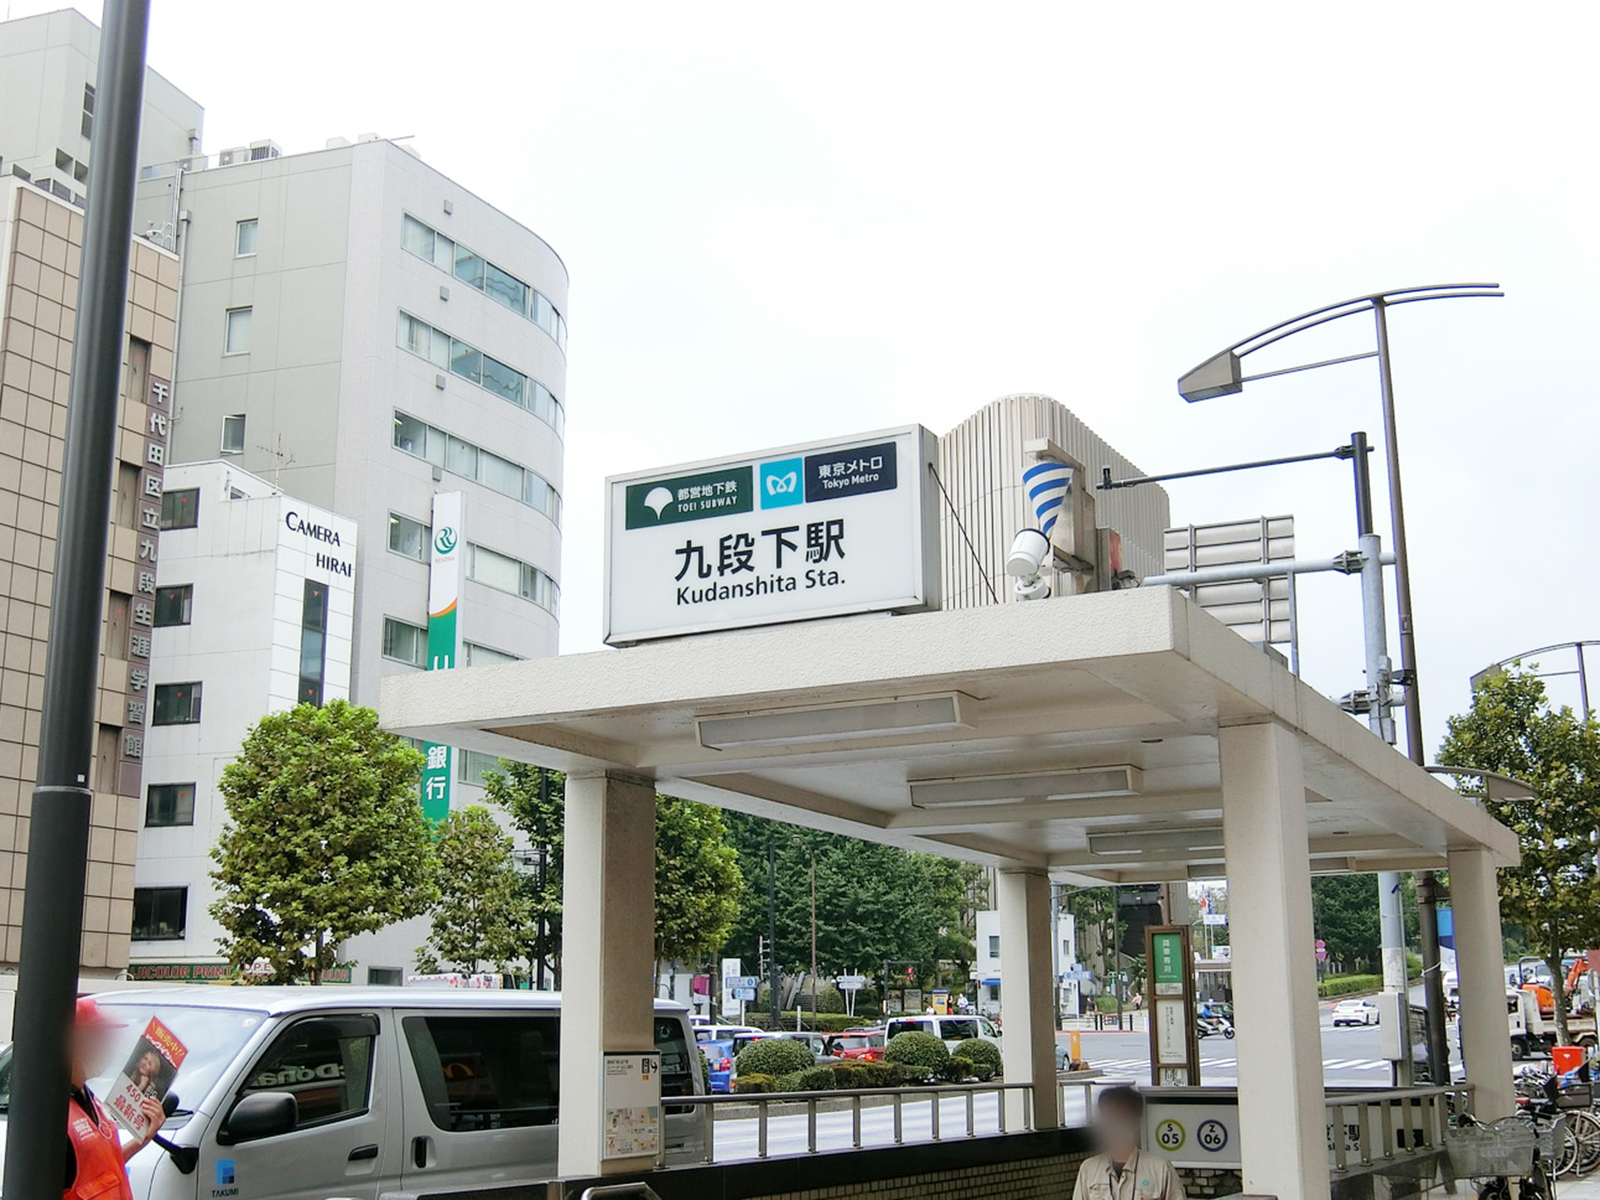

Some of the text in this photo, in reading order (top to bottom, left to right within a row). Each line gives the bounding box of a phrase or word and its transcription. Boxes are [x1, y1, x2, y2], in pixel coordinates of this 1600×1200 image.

[818, 456, 882, 479] 東京メトロ
[677, 480, 738, 501] 都営地下鉄
[822, 473, 879, 490] Tokyo Metro
[677, 495, 738, 513] TOEI SUBWAY
[285, 511, 341, 548] CAMERA
[674, 518, 845, 581] 九段下駅
[125, 381, 169, 759] 千代田区立九段生涯学習館
[315, 552, 352, 578] HIRAI
[676, 569, 846, 605] Kudanshita Sta.
[426, 746, 447, 800] 銀行
[113, 1094, 145, 1131] 最新号
[1167, 1123, 1174, 1133] S
[1209, 1124, 1216, 1133] Z
[1161, 1134, 1180, 1145] 05
[1204, 1134, 1222, 1145] 06
[212, 1188, 239, 1198] TAKUMI
